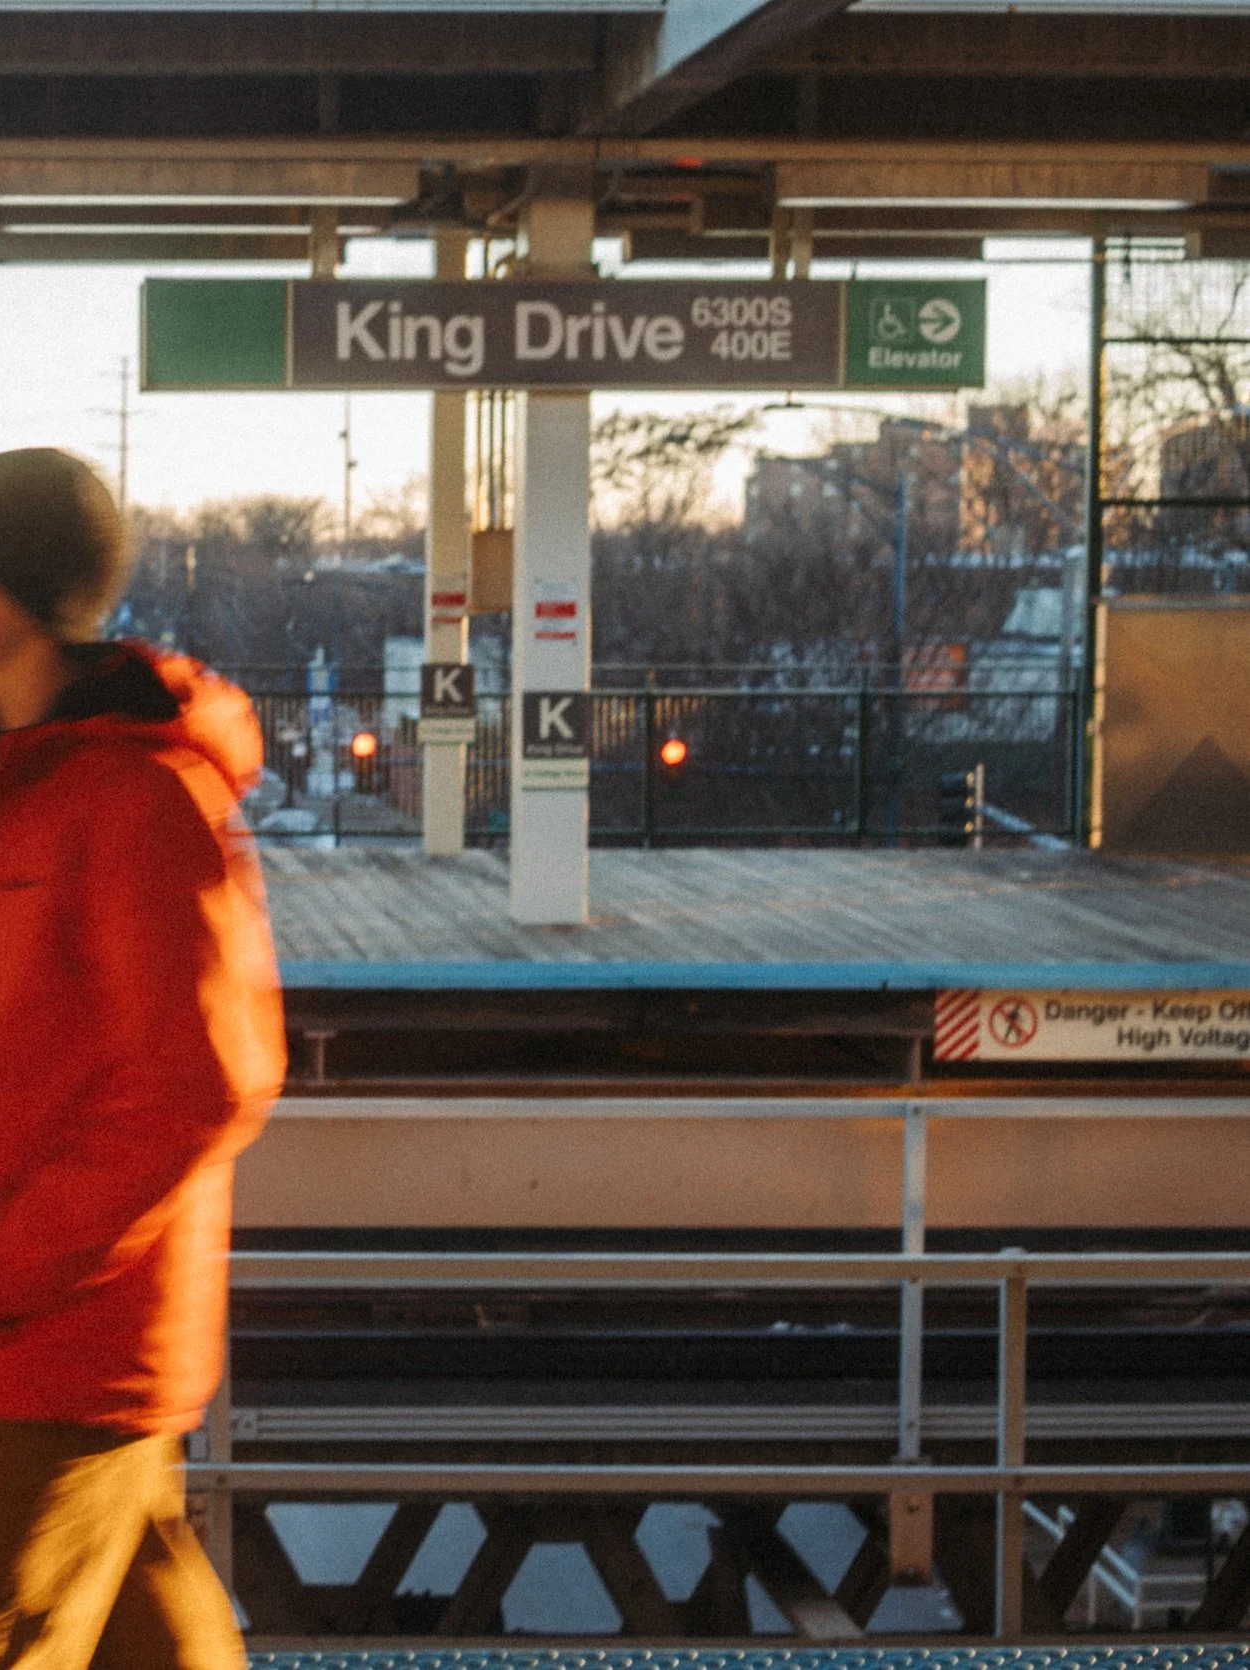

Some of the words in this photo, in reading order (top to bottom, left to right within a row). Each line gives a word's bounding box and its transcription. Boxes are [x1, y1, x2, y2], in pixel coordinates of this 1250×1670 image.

[691, 296, 793, 327] 6300S
[336, 301, 485, 376] King
[515, 301, 686, 361] Drive
[710, 330, 793, 361] 400E
[867, 346, 963, 369] Elevator
[434, 668, 464, 702] K
[539, 697, 575, 739] K
[1045, 1000, 1129, 1026] Danger
[1152, 999, 1212, 1024] Keep
[1117, 1027, 1171, 1051] High
